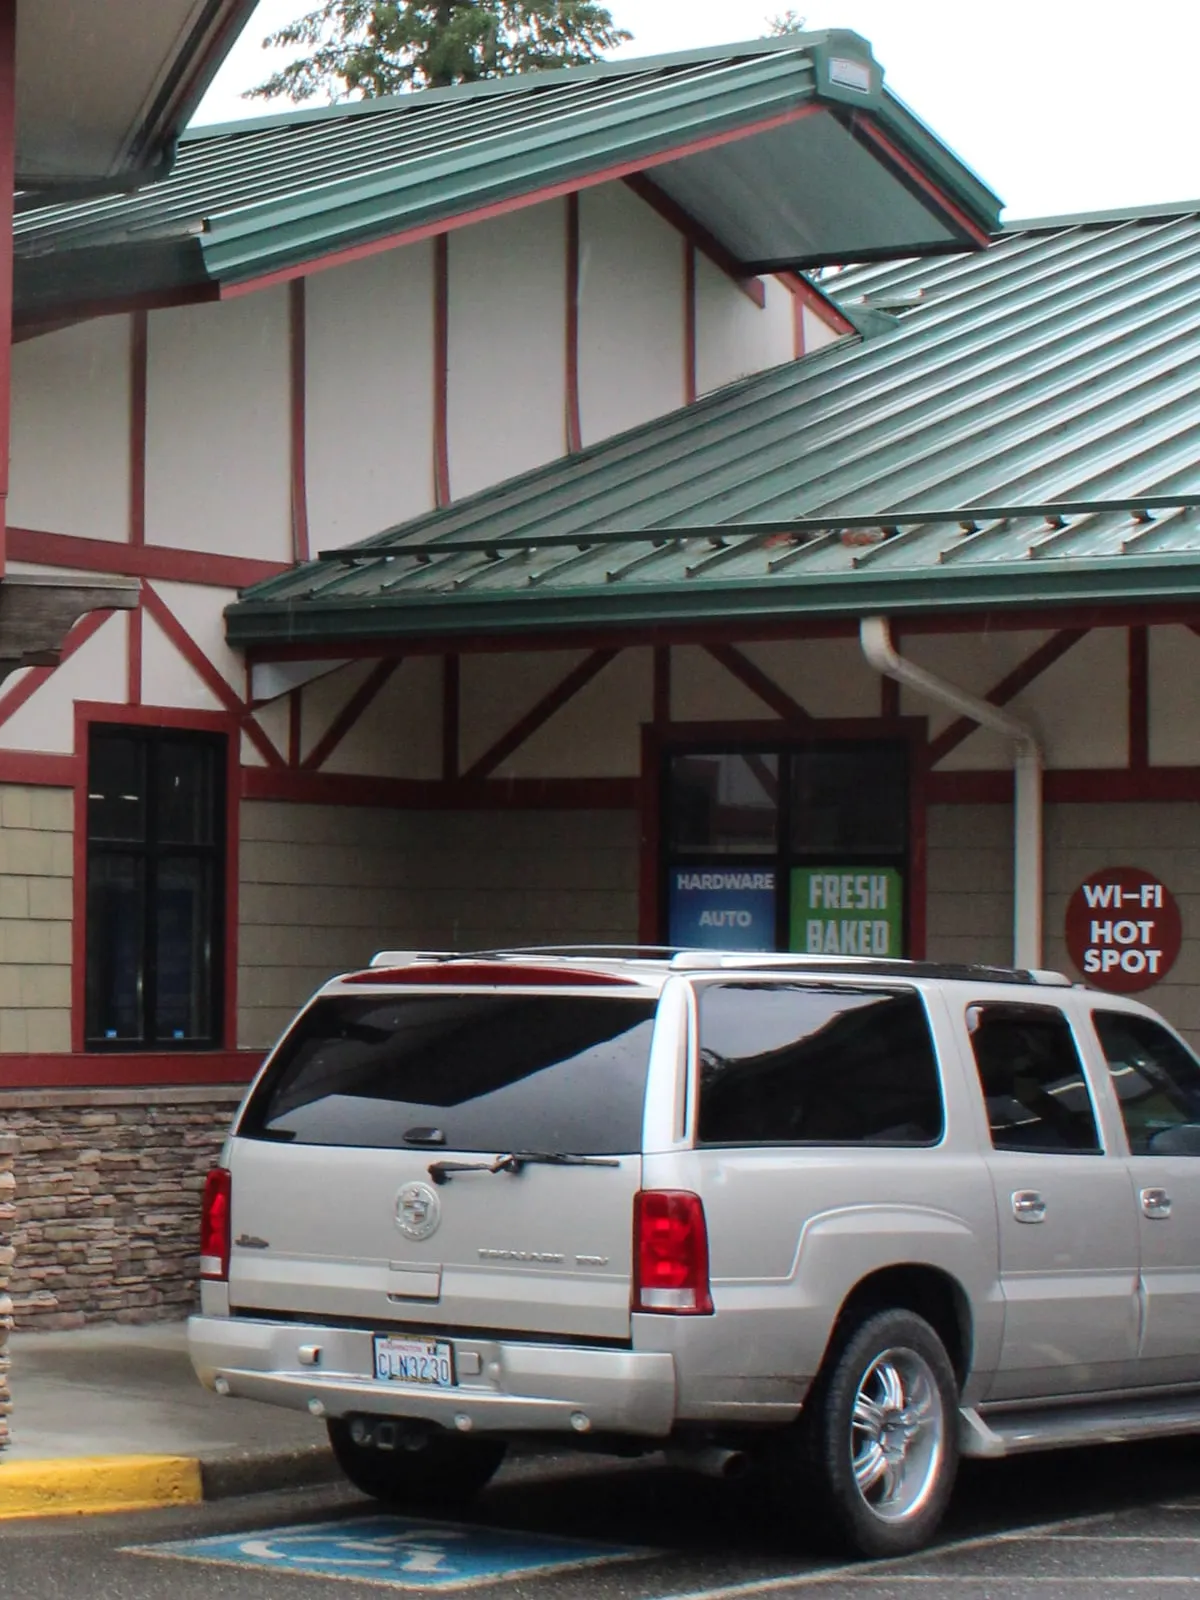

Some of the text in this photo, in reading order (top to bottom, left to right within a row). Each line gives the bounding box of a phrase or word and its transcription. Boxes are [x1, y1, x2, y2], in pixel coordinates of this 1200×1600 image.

[677, 873, 775, 890] HARDWARE
[808, 874, 888, 910] FRESH
[1083, 884, 1163, 908] WI-FI
[699, 910, 753, 927] AUTO
[806, 919, 890, 954] BAKED
[1090, 920, 1154, 945] HOT
[1083, 949, 1163, 974] SPOT
[377, 1353, 449, 1383] CLN3230
